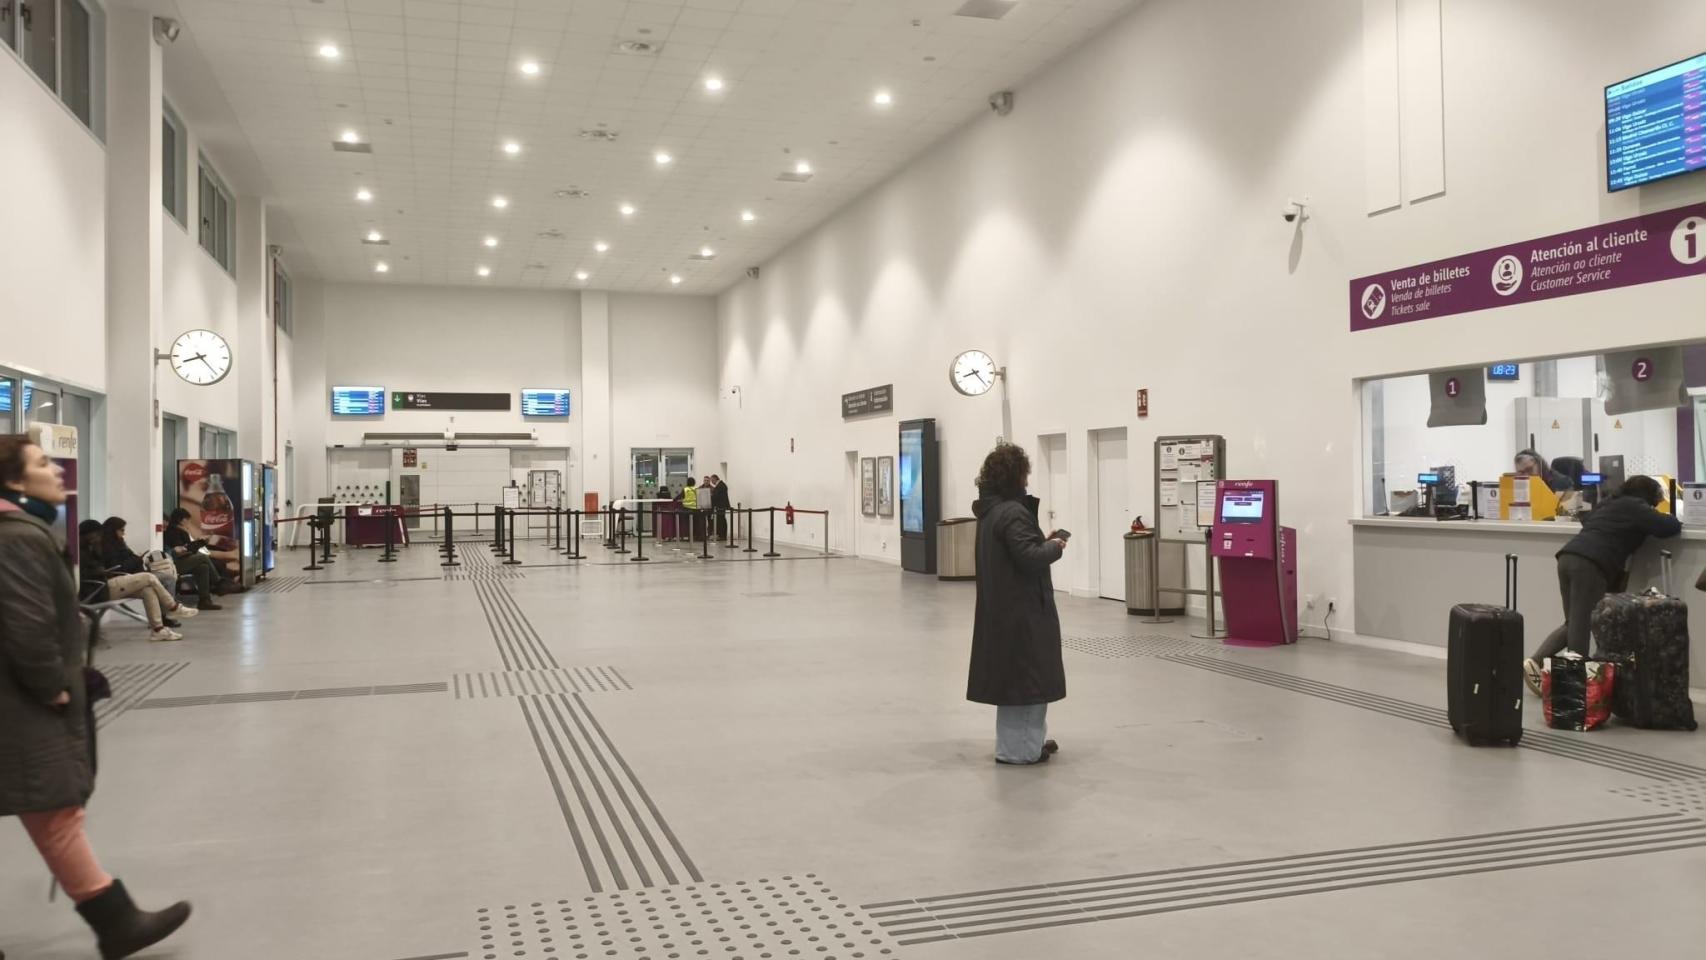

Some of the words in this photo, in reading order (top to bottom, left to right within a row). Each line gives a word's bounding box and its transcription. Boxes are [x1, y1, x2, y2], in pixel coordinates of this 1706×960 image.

[1530, 242, 1582, 263] Atención
[1586, 236, 1598, 252] al
[1602, 228, 1648, 248] cliente
[1530, 260, 1570, 278] Atención
[1574, 258, 1586, 271] ao
[1588, 252, 1622, 268] cliente
[1390, 278, 1416, 291] Venta
[1418, 272, 1430, 286] de
[1433, 266, 1470, 282] billetes
[1530, 276, 1573, 292] Customer
[1576, 268, 1612, 284] Service
[1391, 290, 1413, 303] Venda
[1414, 288, 1425, 298] de
[1424, 284, 1452, 296] billetes
[1391, 304, 1414, 316] Tickets
[1415, 300, 1430, 312] sale
[1636, 362, 1647, 378] 2
[1448, 380, 1457, 394] 1
[58, 432, 77, 456] renfe
